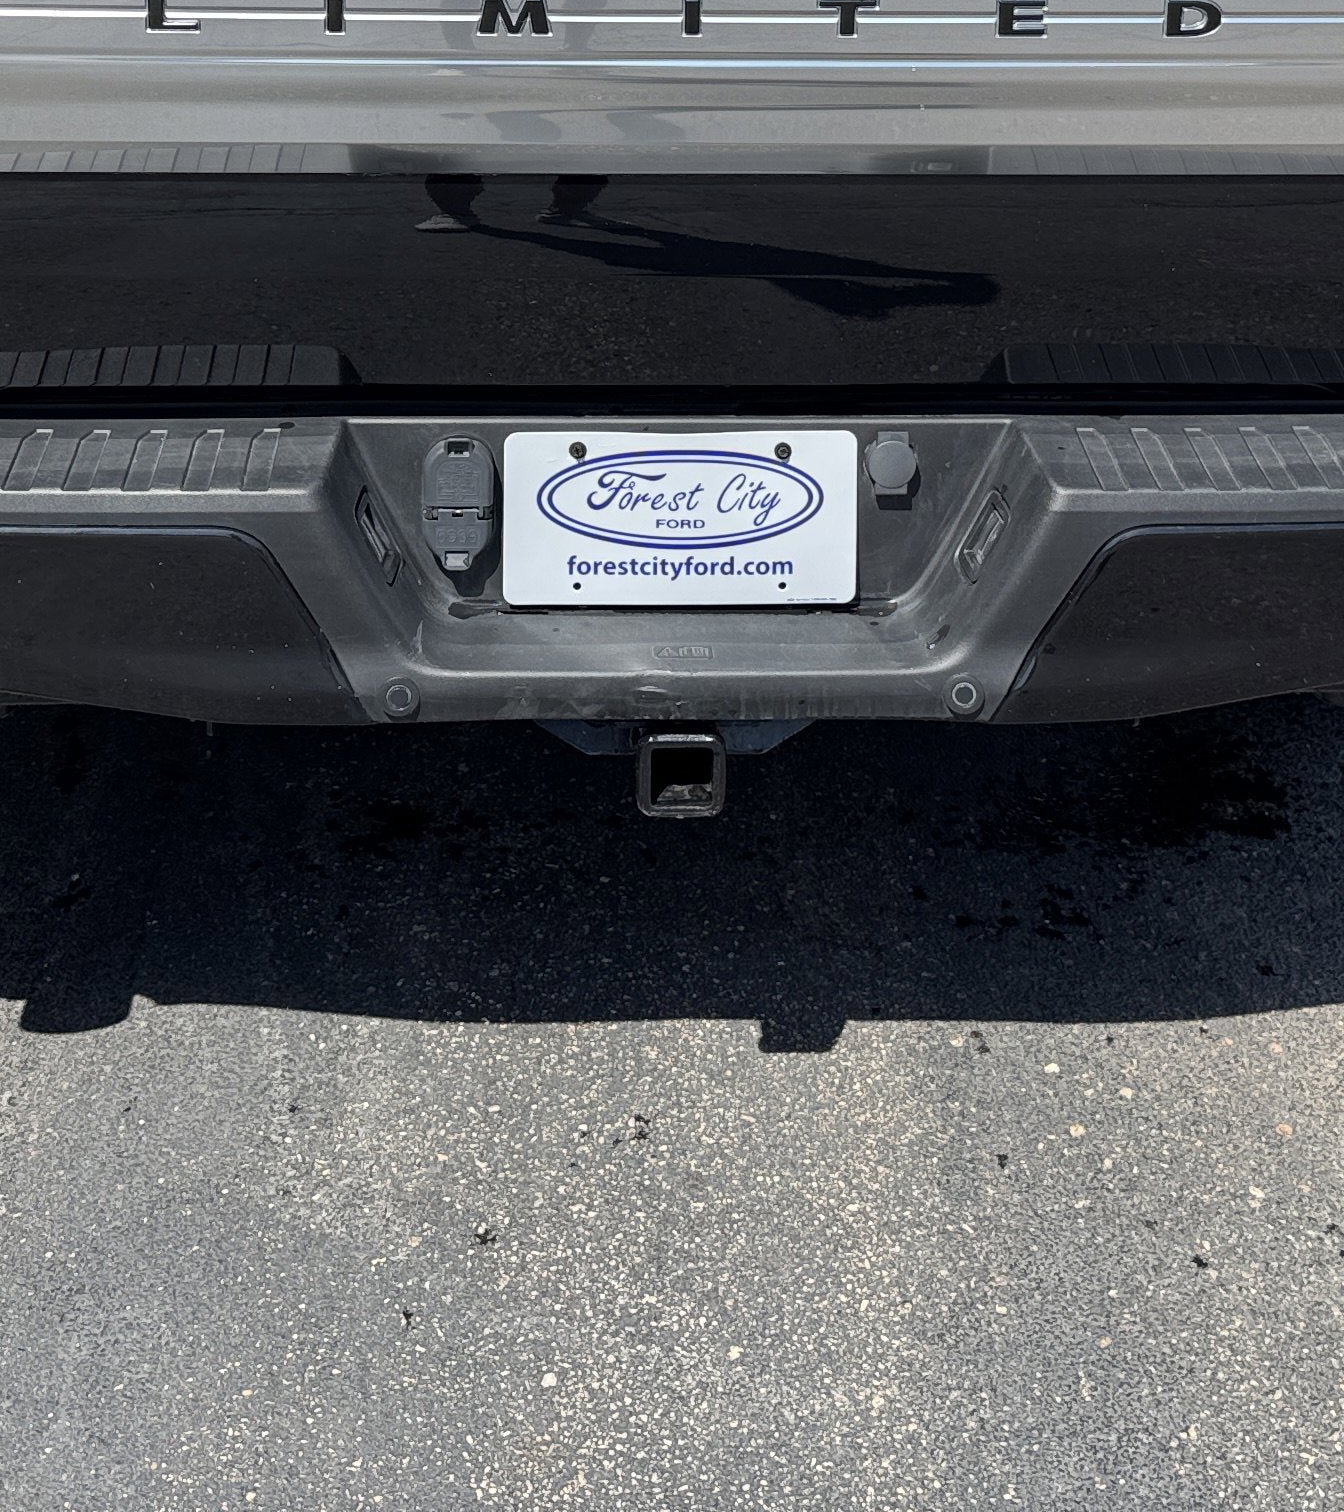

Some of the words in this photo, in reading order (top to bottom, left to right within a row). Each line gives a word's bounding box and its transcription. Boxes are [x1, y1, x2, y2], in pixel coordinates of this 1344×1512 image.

[587, 470, 704, 512] Forest
[716, 473, 781, 526] City
[655, 518, 706, 529] FORD
[567, 555, 794, 581] forestcityford.com
